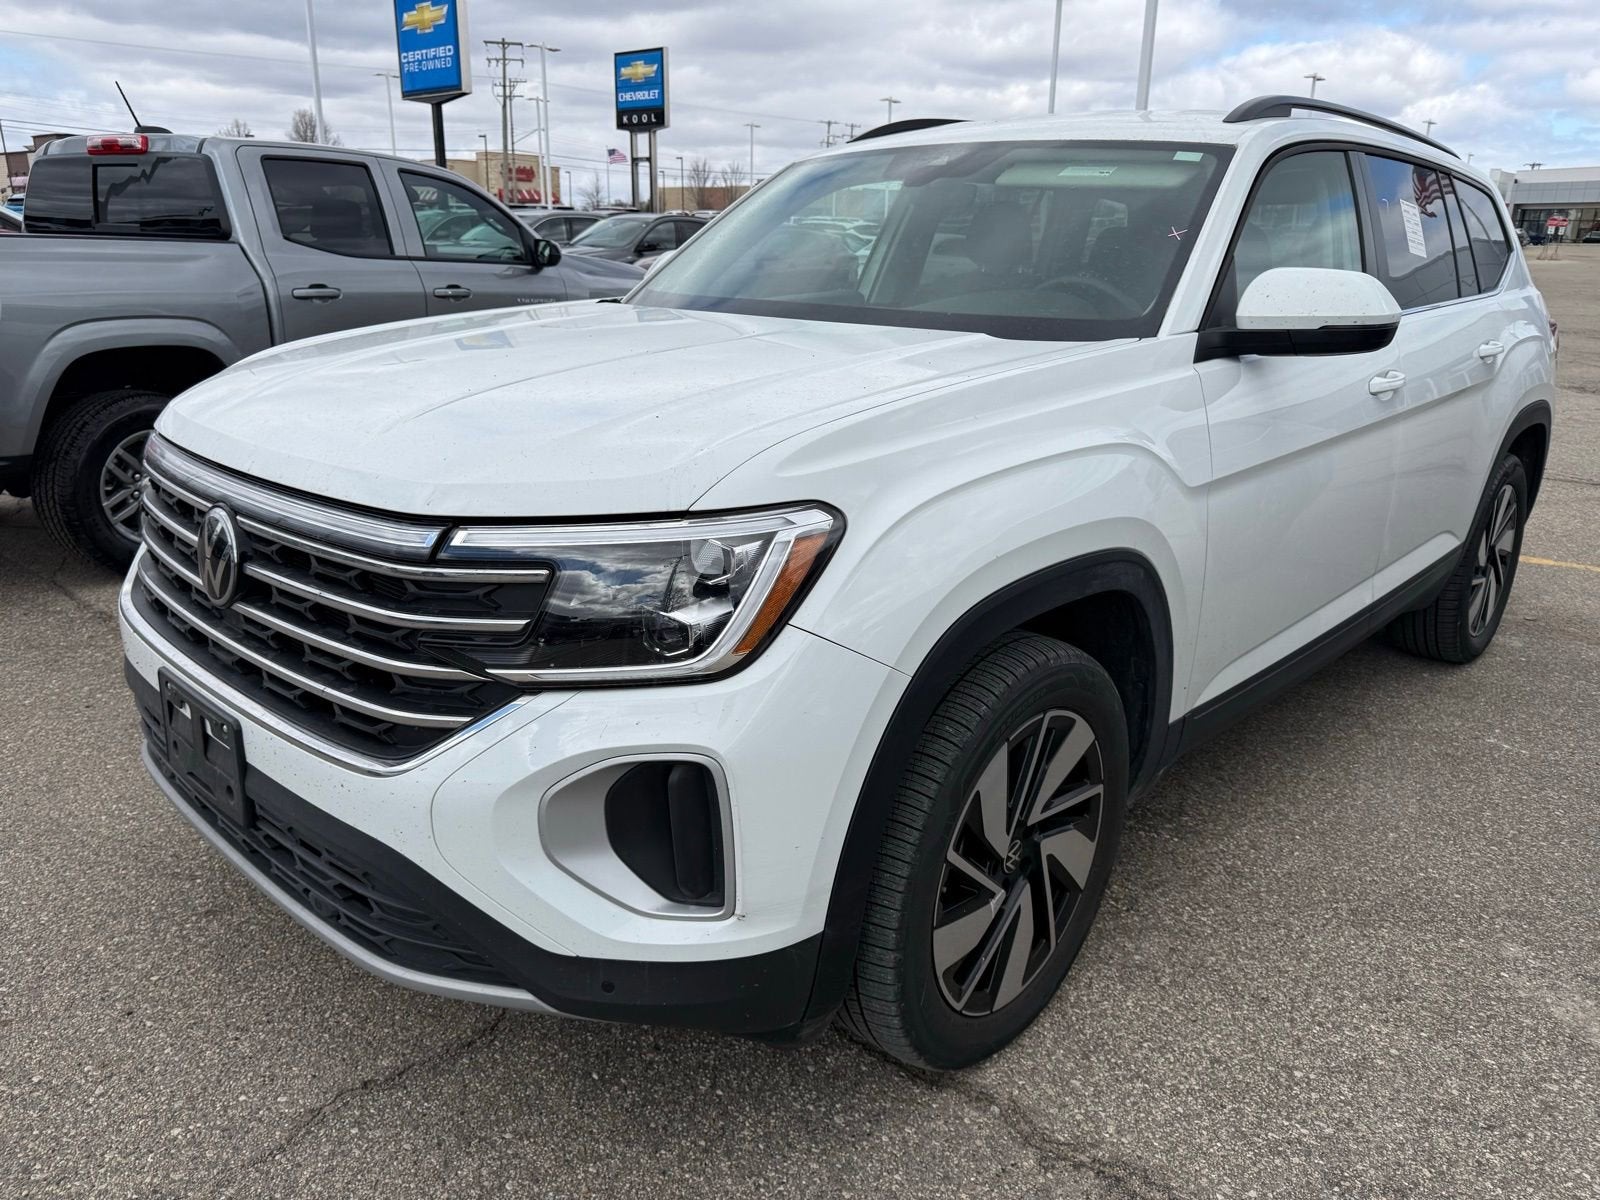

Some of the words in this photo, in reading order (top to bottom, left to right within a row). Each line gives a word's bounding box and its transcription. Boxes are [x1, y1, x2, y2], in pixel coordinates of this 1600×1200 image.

[401, 45, 454, 62] CERTIFIED
[403, 57, 452, 73] PRE-OWNED
[618, 90, 660, 102] CHEVROLET
[622, 113, 657, 124] KOOL
